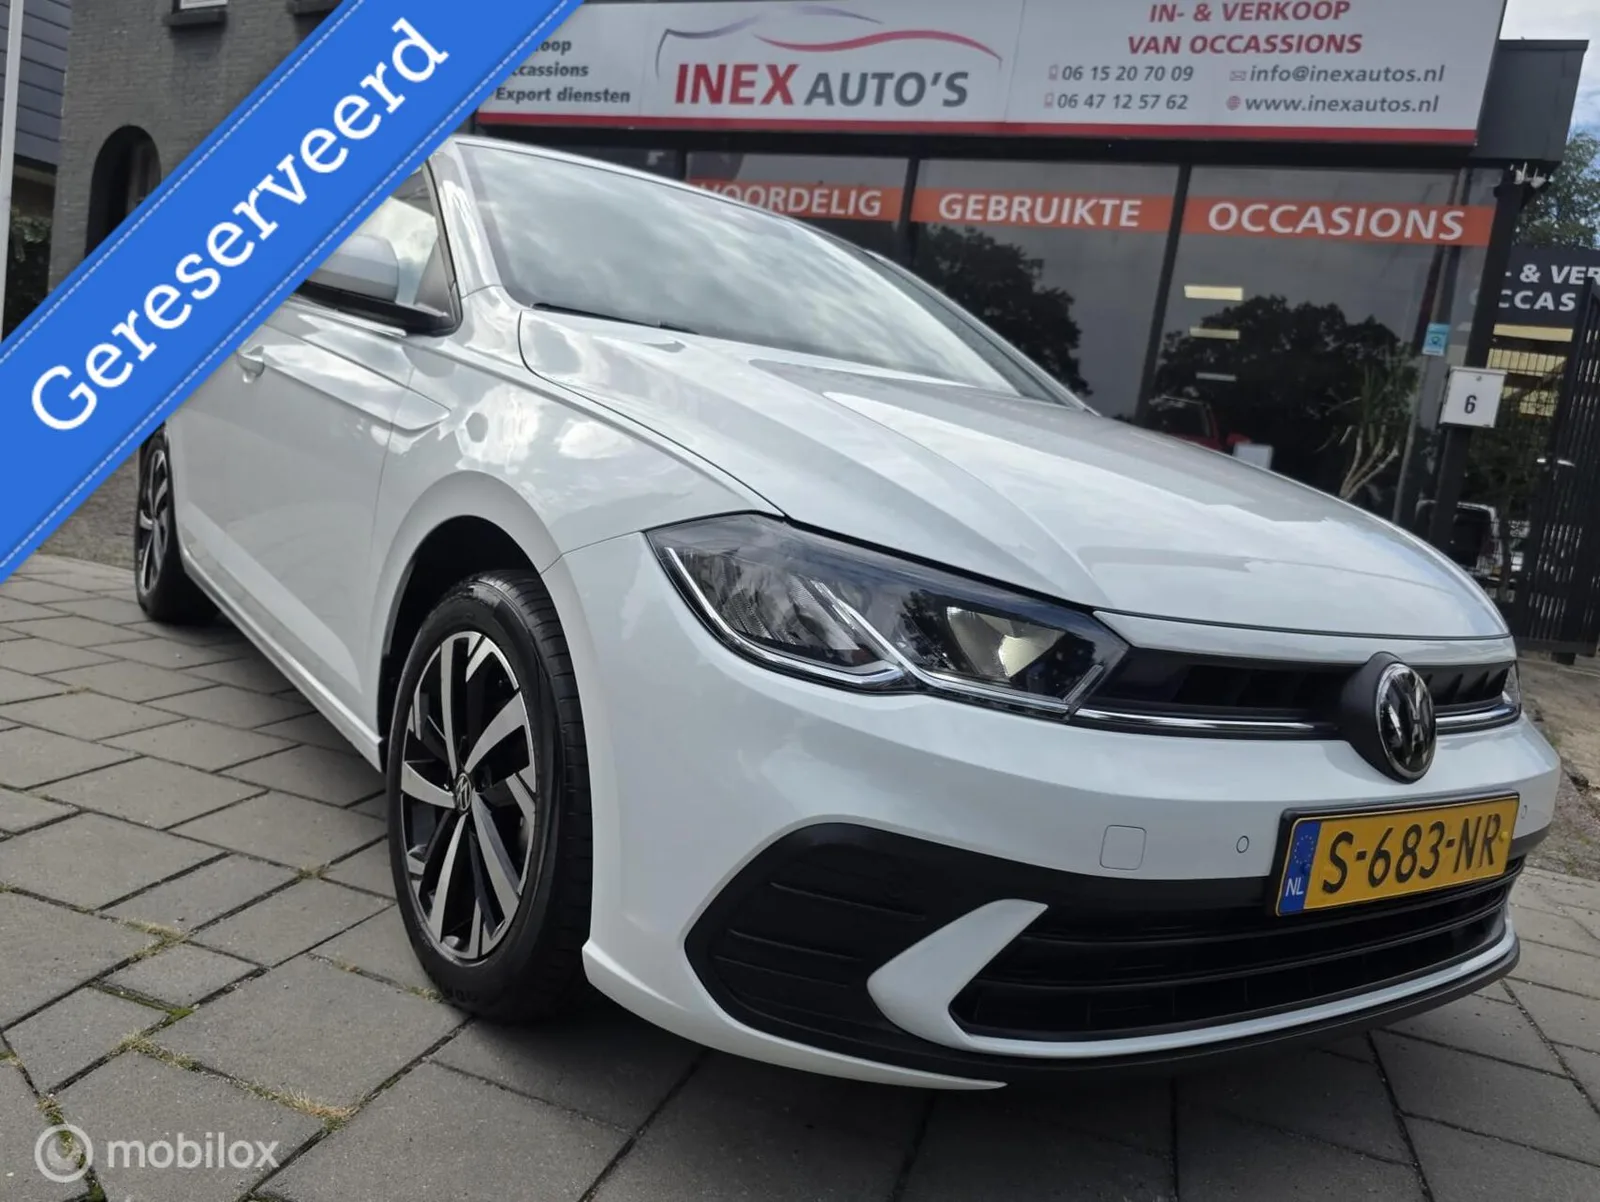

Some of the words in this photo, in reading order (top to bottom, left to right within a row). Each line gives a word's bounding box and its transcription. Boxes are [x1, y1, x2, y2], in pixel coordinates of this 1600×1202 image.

[1149, 3, 1185, 22] IN-
[1193, 2, 1212, 22] &
[1222, 0, 1351, 21] VERKOOP
[1128, 36, 1182, 55] VAN
[1189, 33, 1363, 55] OCCASSIONS
[1062, 65, 1084, 81] 06
[1091, 65, 1111, 81] 15
[1115, 65, 1138, 81] 20
[1144, 65, 1166, 82] 70
[1171, 65, 1194, 82] 09
[1250, 64, 1445, 83] info@inexautos.nl
[675, 63, 799, 106] INEX
[803, 71, 969, 108] AUTO'S
[495, 87, 551, 104] Export
[556, 87, 631, 103] diensten
[1057, 93, 1079, 109] 06
[1084, 93, 1106, 109] 47
[1113, 94, 1132, 110] 12
[1138, 94, 1161, 110] 57
[1166, 94, 1188, 110] 62
[1245, 95, 1439, 113] www.inexautos.nl
[938, 193, 1142, 227] GEBRUIKTE
[1208, 203, 1465, 241] OCCASIONS
[1520, 263, 1541, 283] &
[1464, 395, 1477, 414] 6
[1322, 813, 1500, 895] S-683-NR
[1285, 879, 1303, 897] NL
